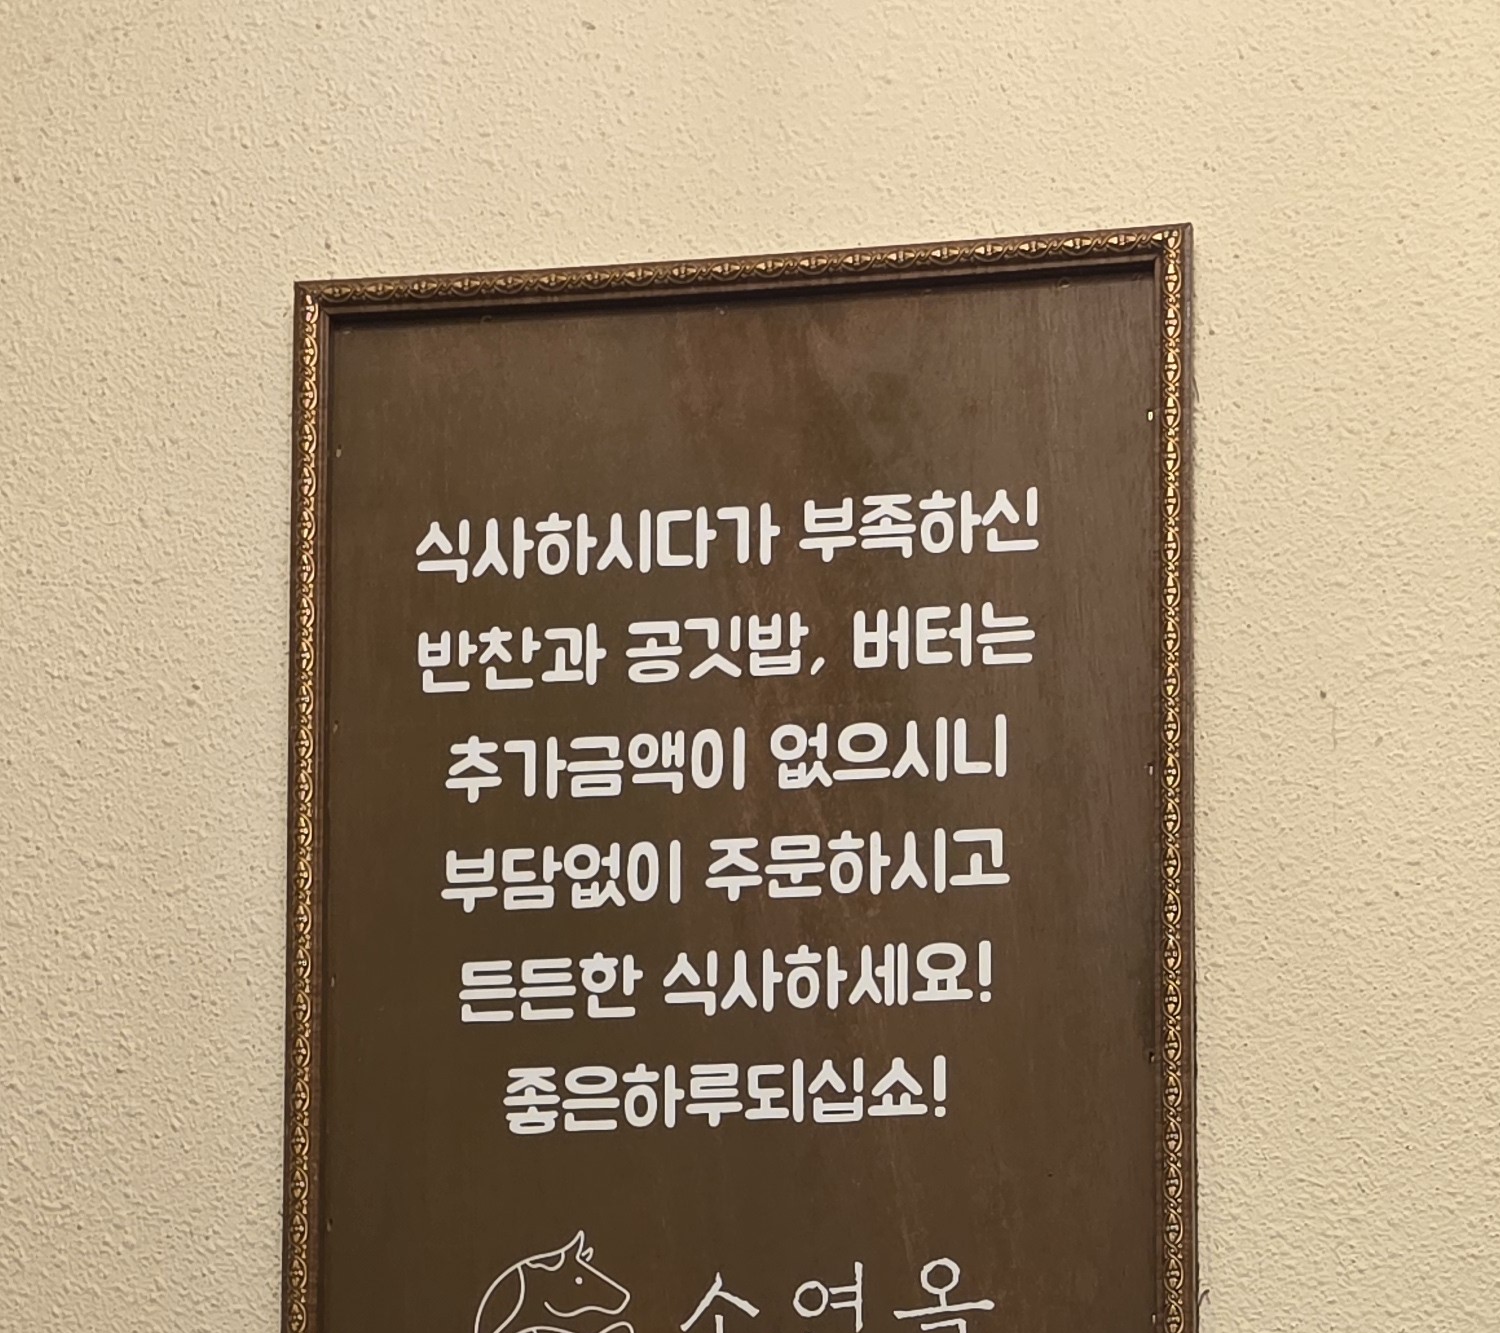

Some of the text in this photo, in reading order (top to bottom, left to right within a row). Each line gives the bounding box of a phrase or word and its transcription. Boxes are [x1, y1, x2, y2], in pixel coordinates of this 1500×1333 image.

[415, 486, 1040, 584] 식사하시다가 부족하신
[417, 601, 1036, 694] 반찬과 공깃밥, 버터는
[445, 713, 1007, 804] 추가금액이 없으시니
[440, 827, 1011, 913] 부담없이 주문하시고
[458, 940, 992, 1023] 든든한 식사하세요!
[502, 1054, 947, 1135] 좋은하루되십쇼!
